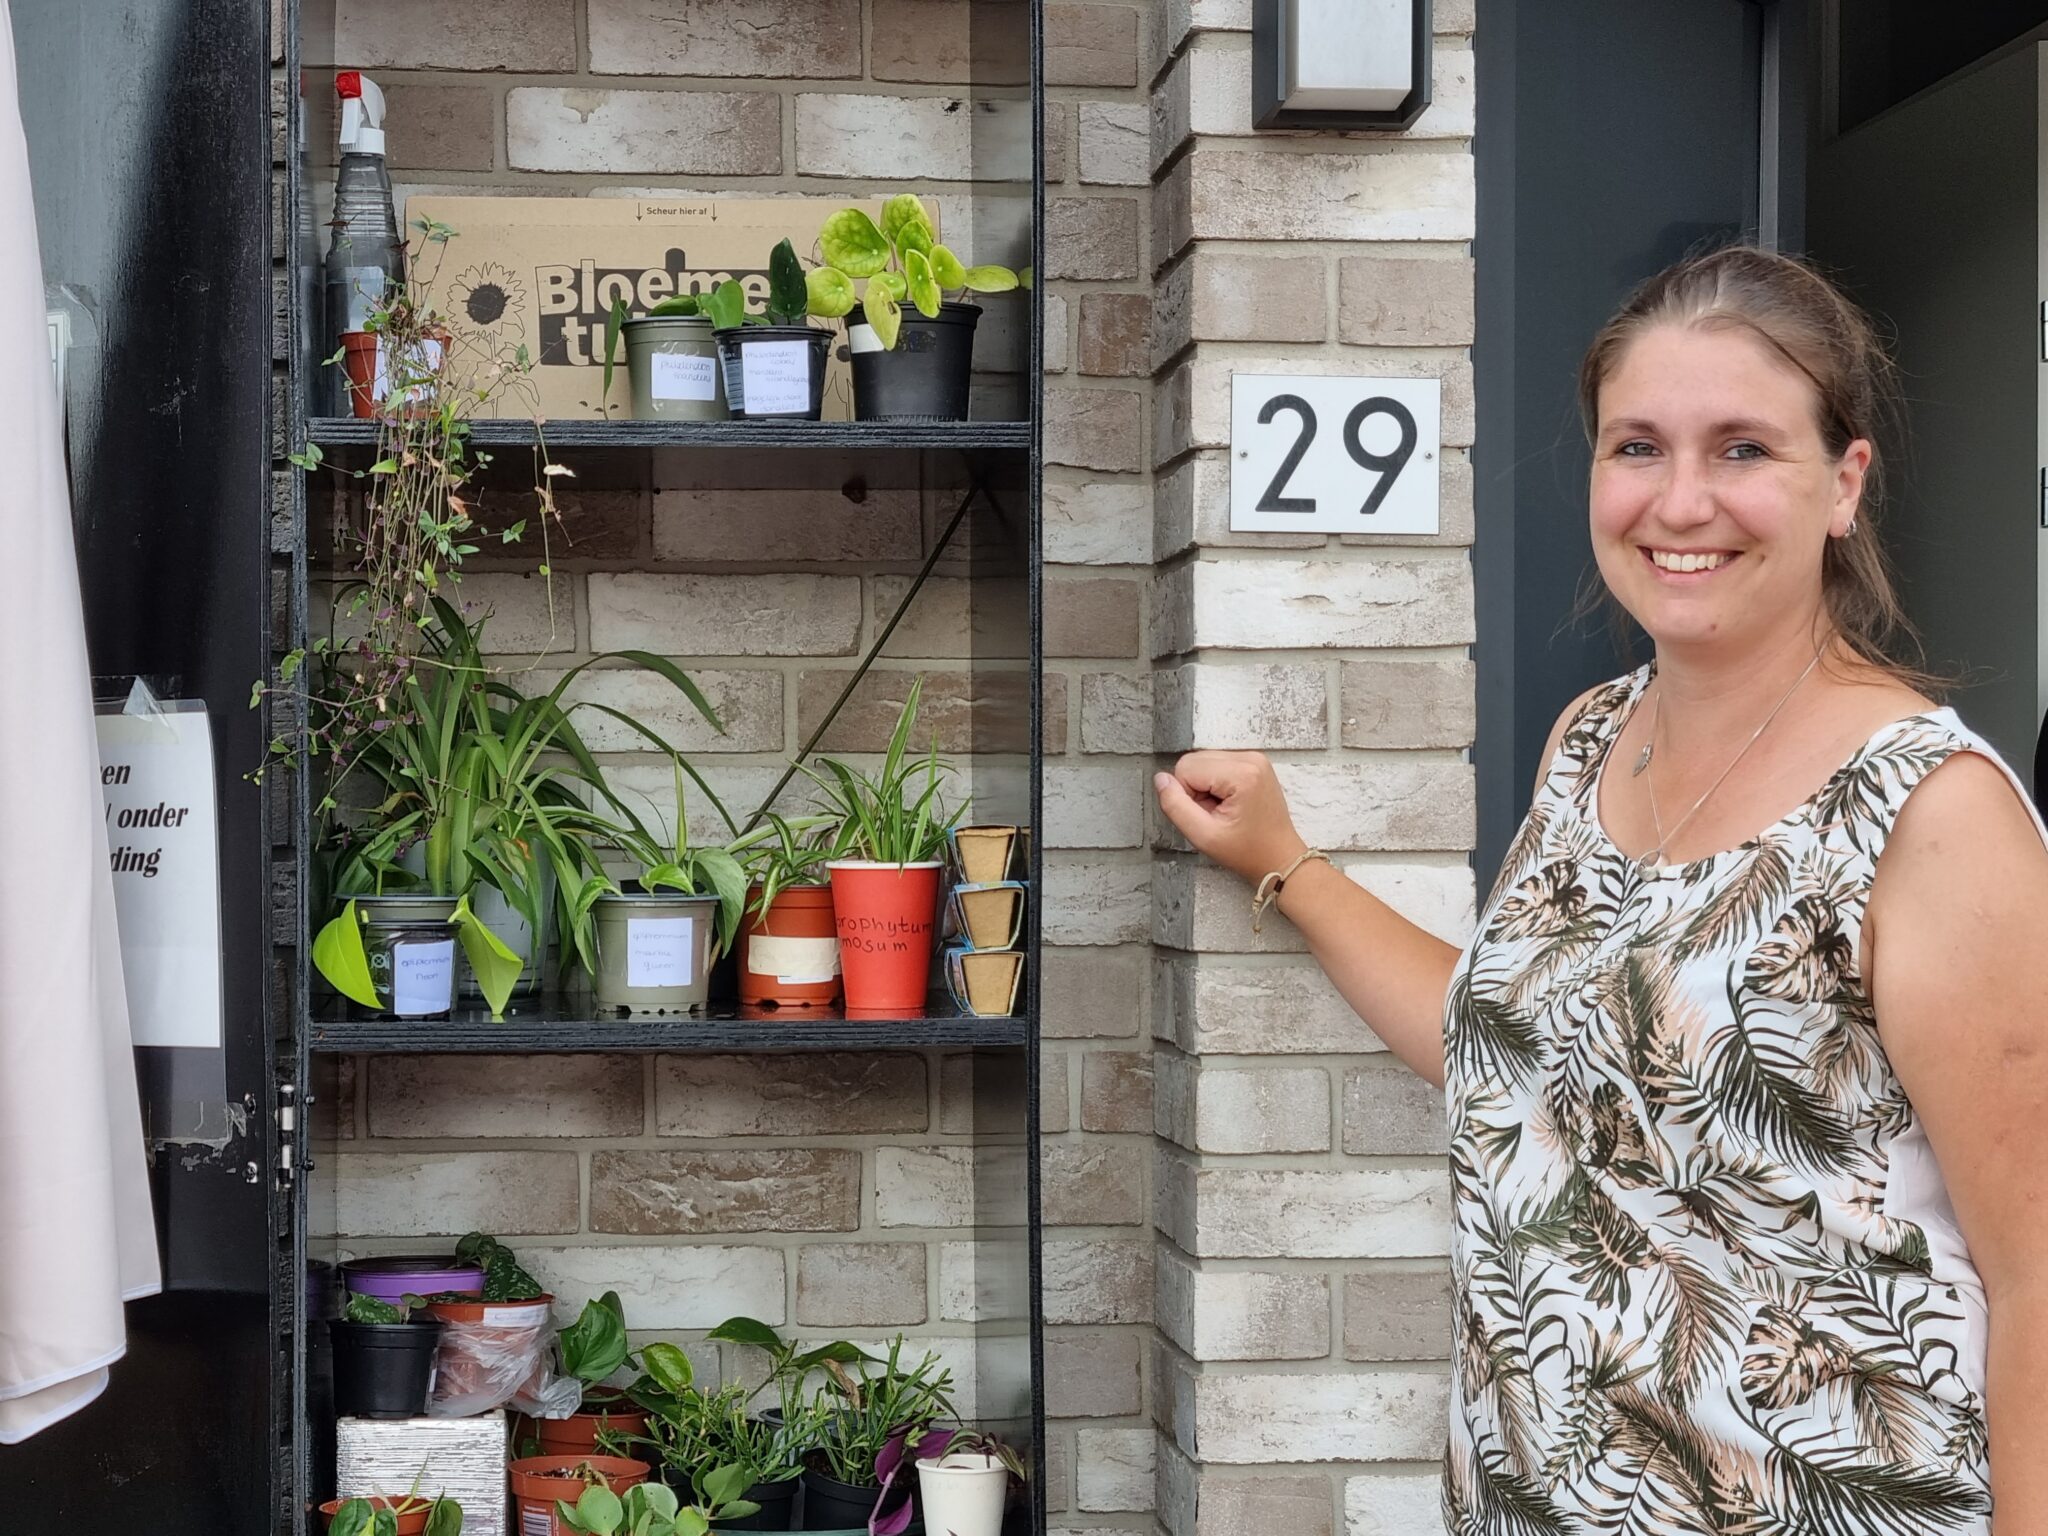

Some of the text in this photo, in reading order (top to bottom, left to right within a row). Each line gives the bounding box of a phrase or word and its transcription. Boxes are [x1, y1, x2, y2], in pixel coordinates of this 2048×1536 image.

[646, 206, 708, 216] Scheur hier af
[535, 259, 771, 315] Bloeme
[1255, 393, 1418, 515] 29
[100, 764, 131, 785] en
[117, 802, 189, 828] onder
